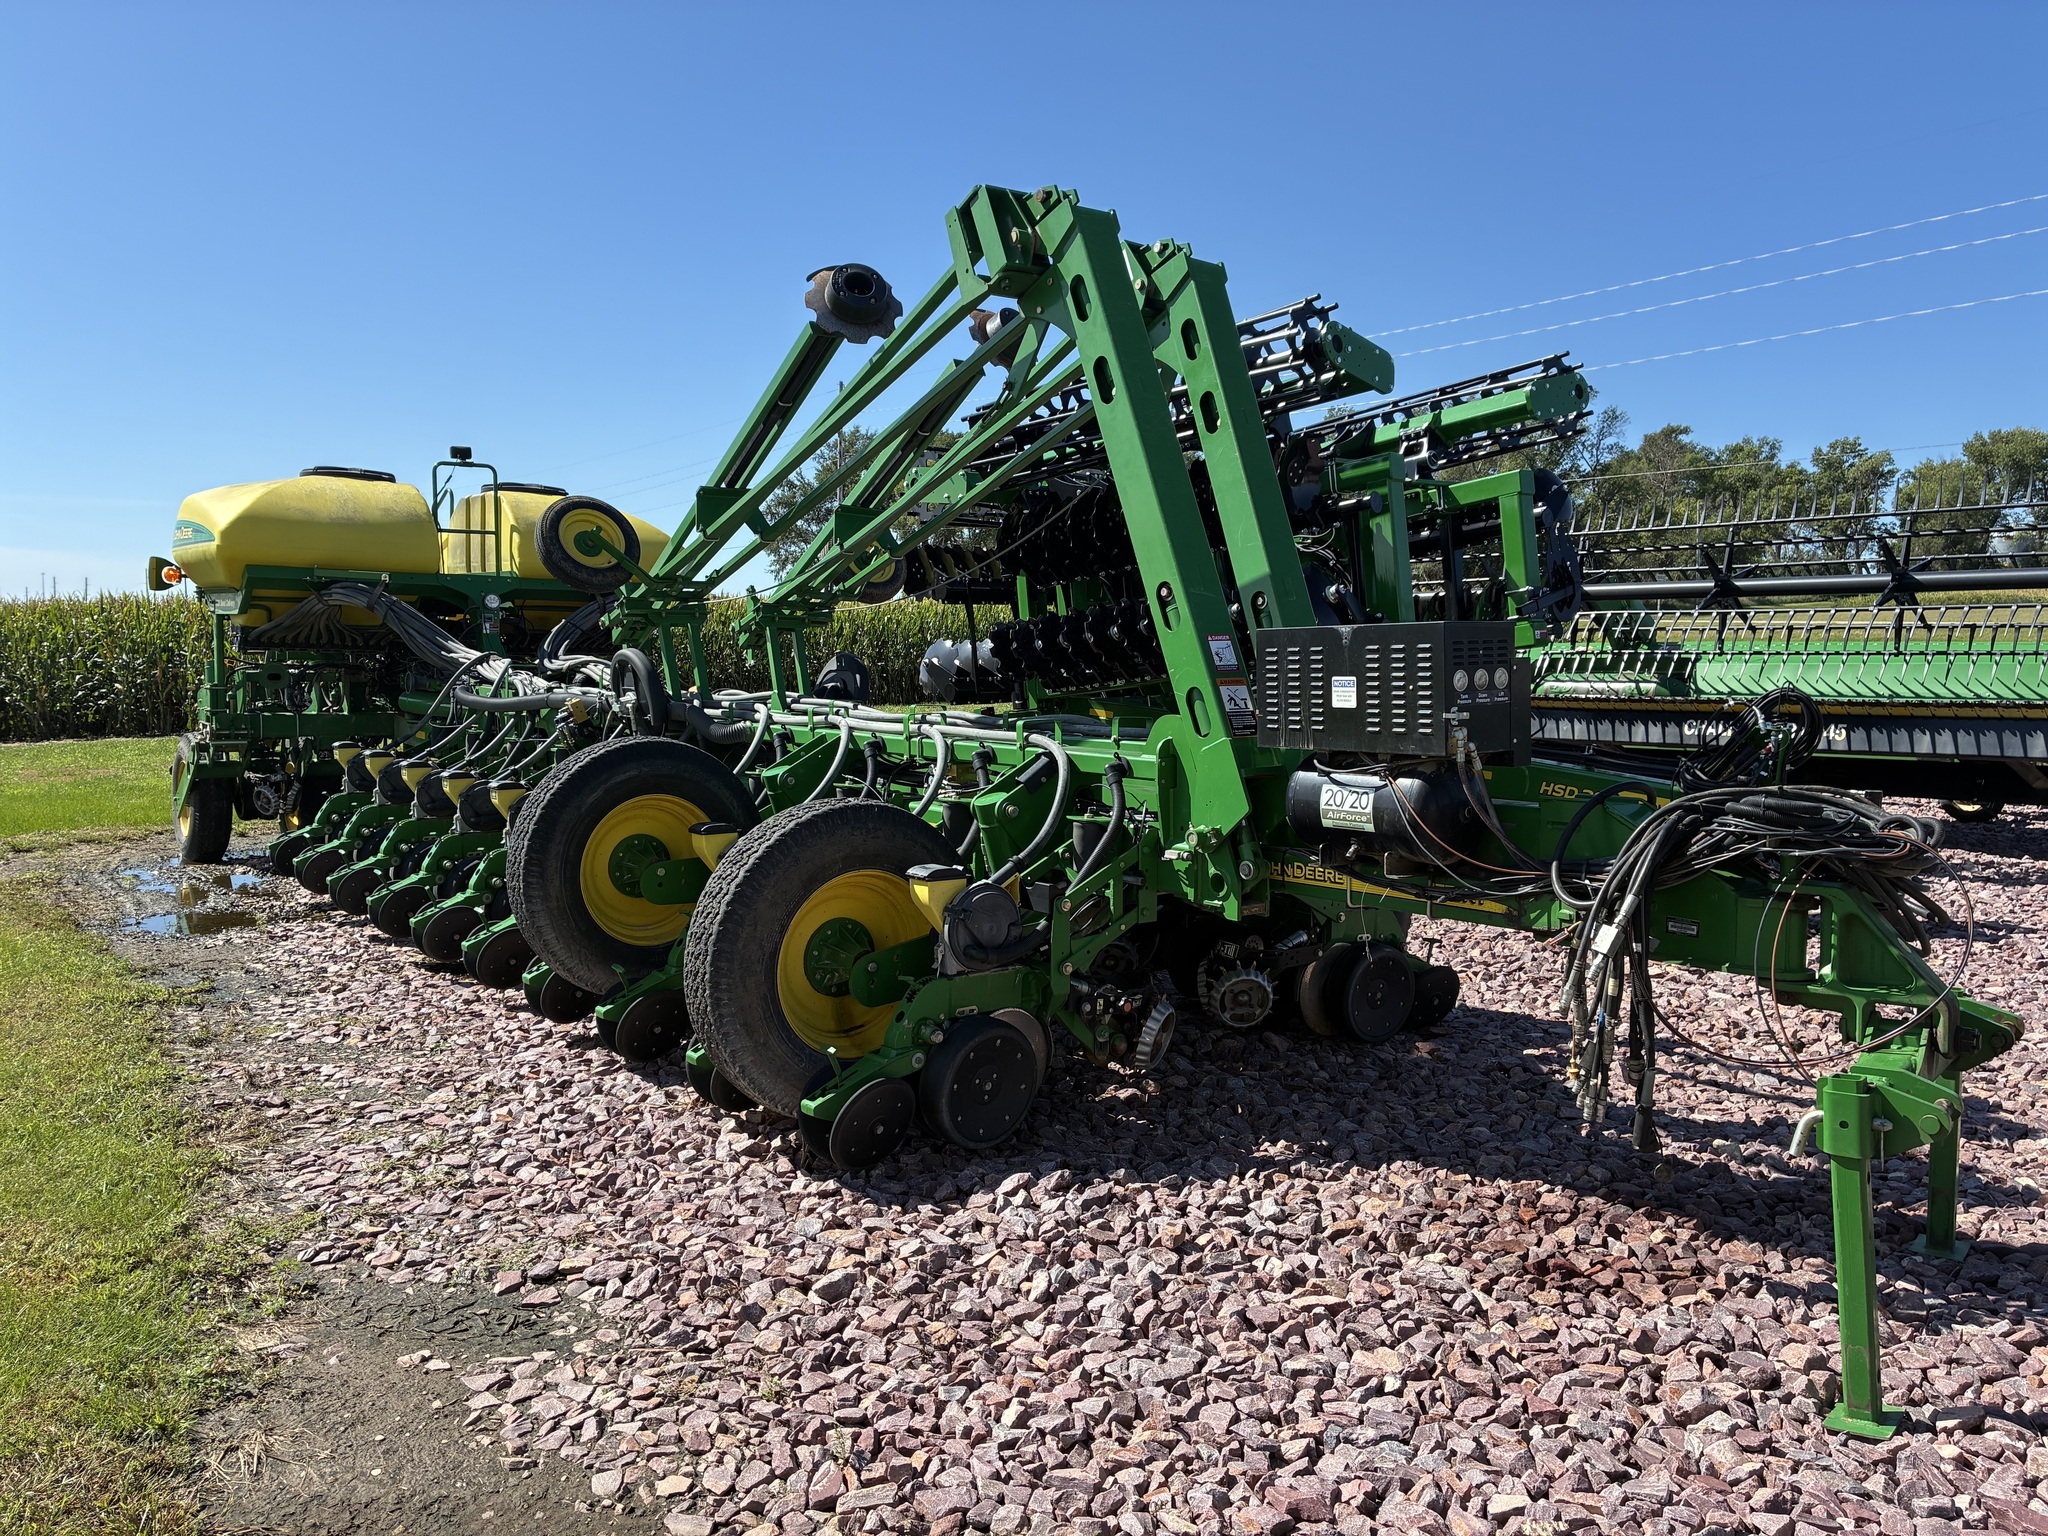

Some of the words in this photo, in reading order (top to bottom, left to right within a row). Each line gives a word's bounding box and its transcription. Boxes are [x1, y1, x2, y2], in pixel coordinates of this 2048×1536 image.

[1324, 789, 1370, 810] 20/20
[1540, 782, 1579, 799] HSD
[1327, 811, 1368, 822] AirForce
[1294, 862, 1344, 883] DEERE
